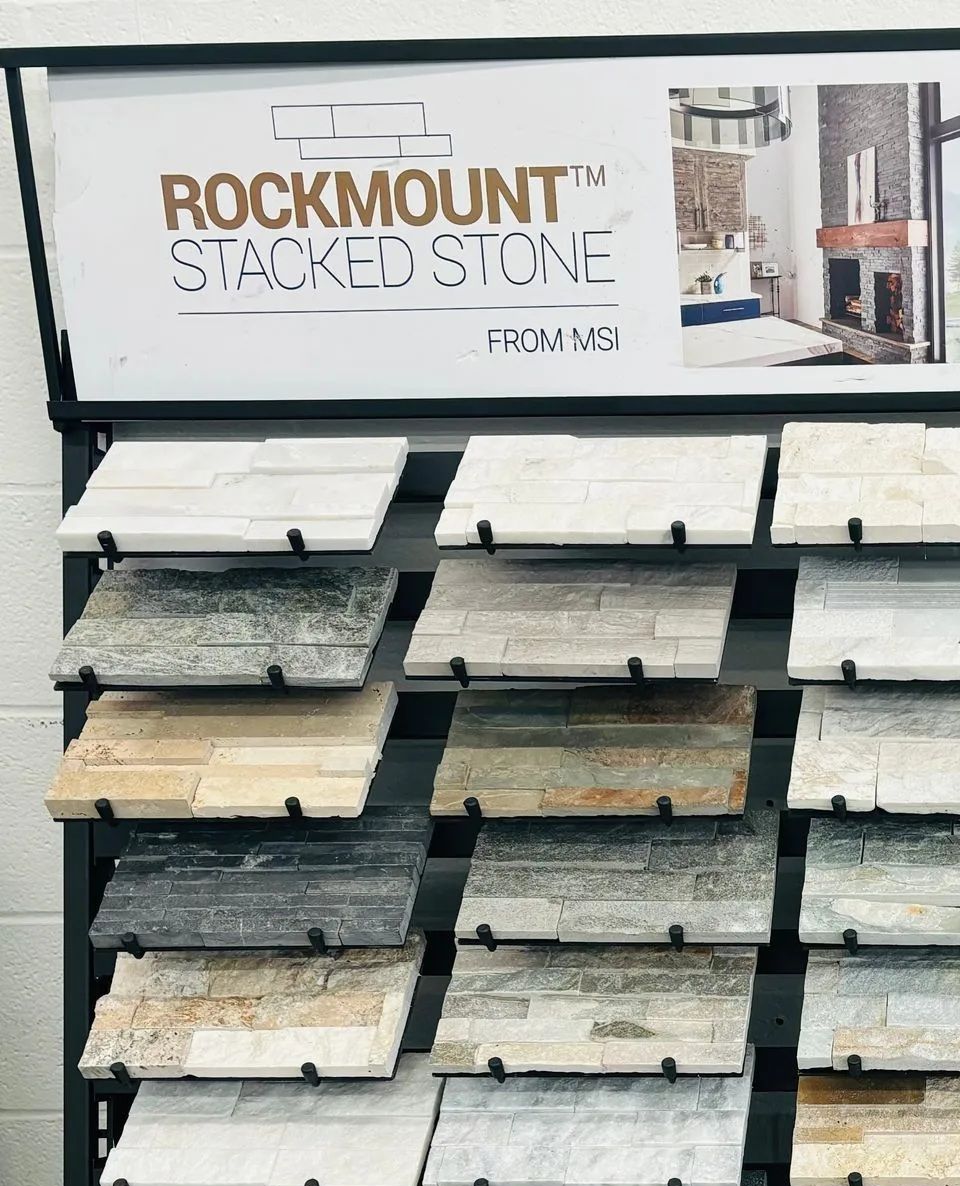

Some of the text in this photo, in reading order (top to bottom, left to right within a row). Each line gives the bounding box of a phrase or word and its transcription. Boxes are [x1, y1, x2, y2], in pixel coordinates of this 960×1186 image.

[171, 231, 616, 292] STACKED STONE
[488, 327, 619, 353] FROM MSI
